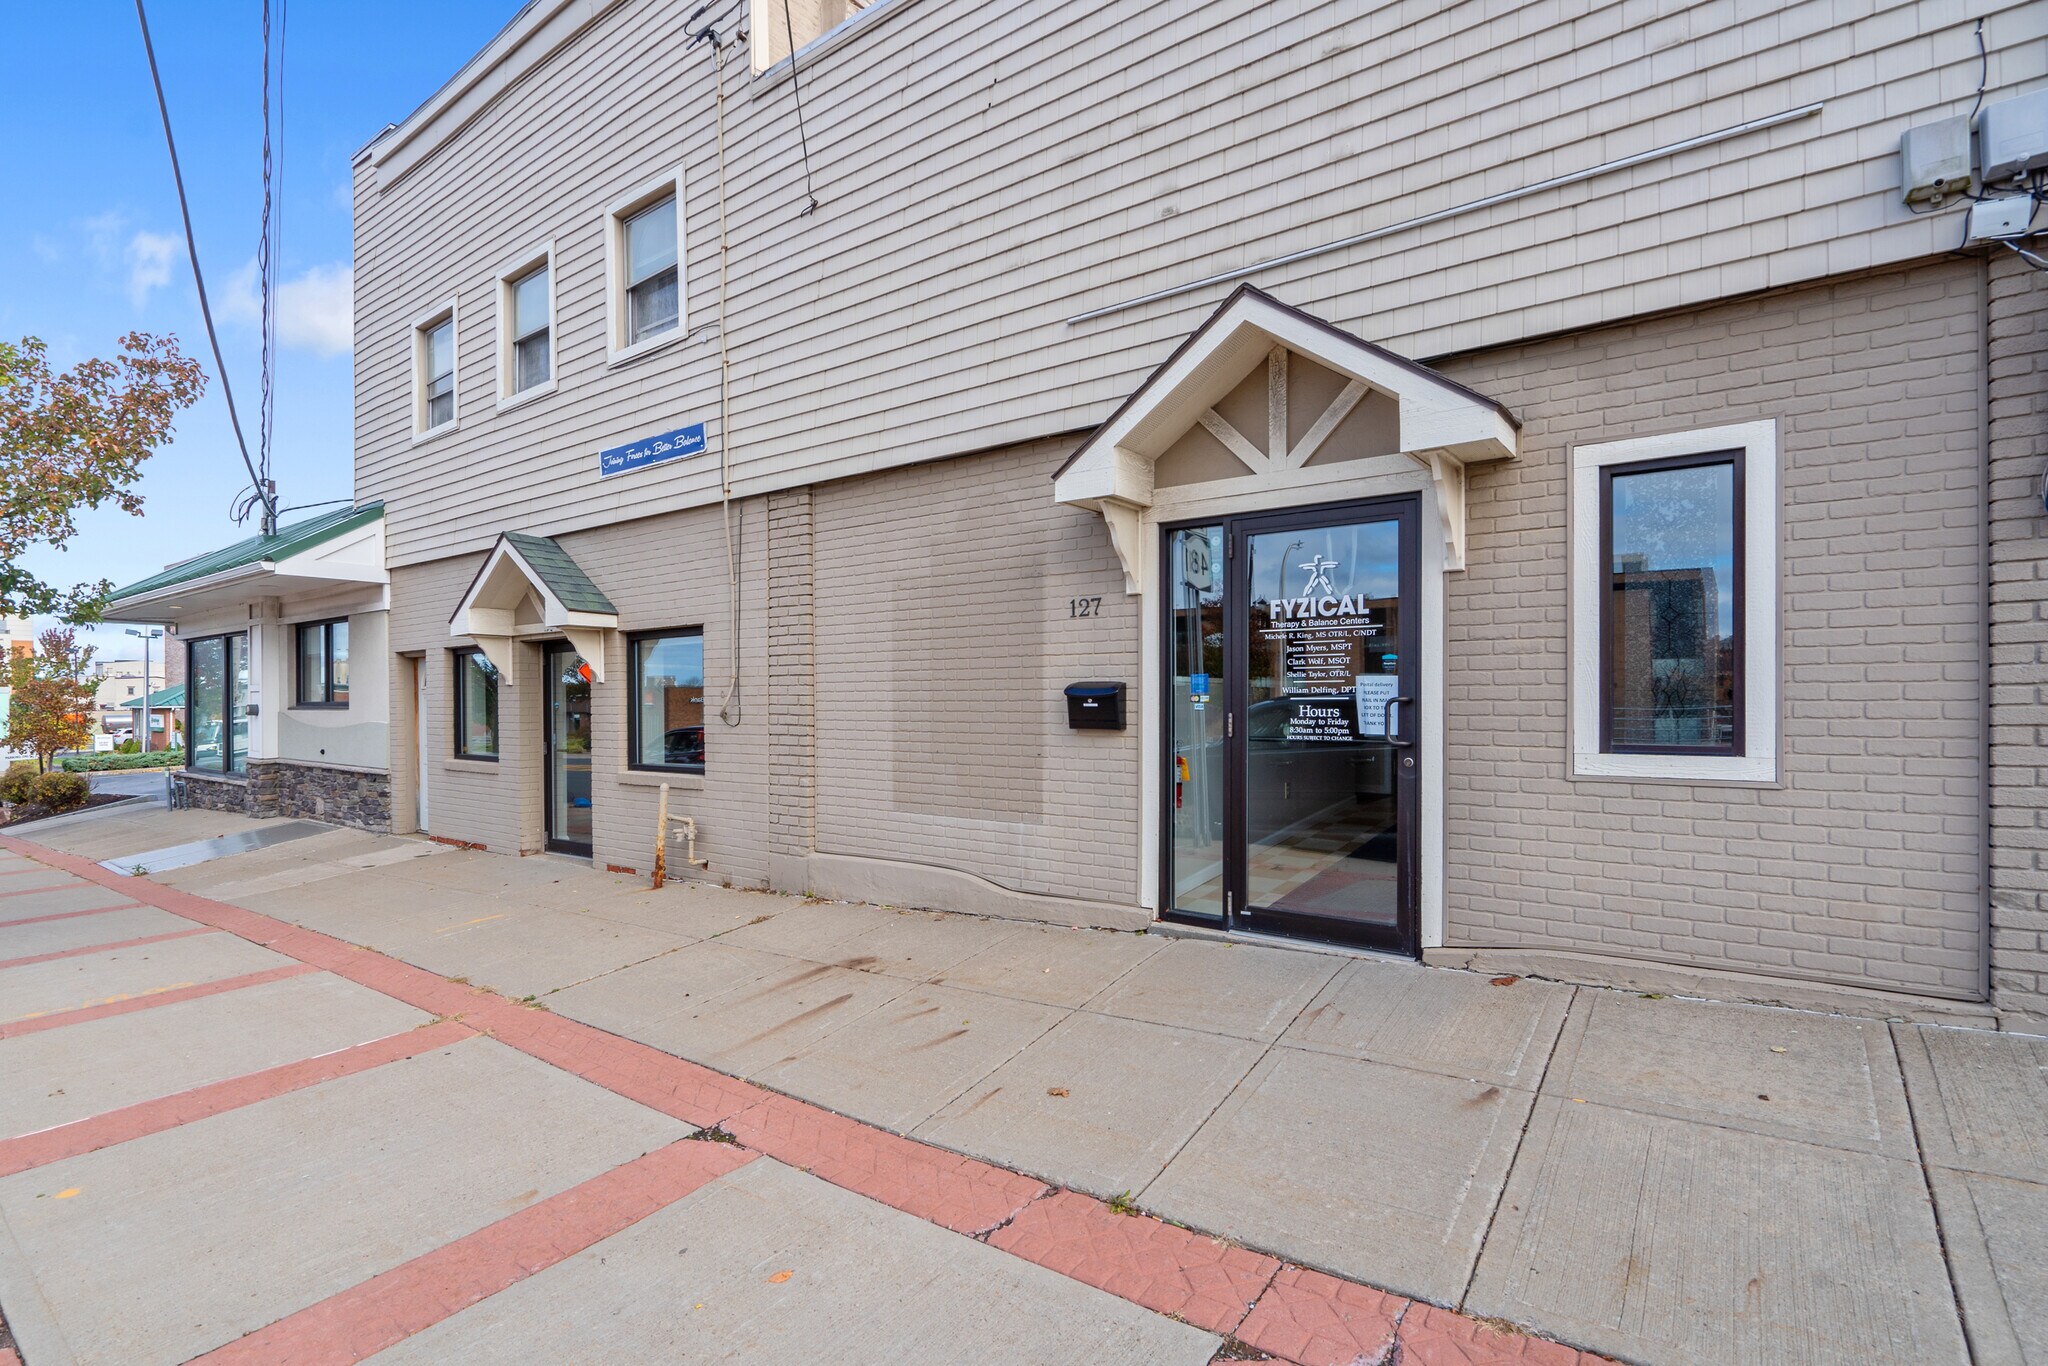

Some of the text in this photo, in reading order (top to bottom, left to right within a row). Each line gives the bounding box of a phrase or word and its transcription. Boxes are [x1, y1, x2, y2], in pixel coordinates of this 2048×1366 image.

[644, 448, 652, 458] for
[652, 442, 672, 455] Better
[674, 434, 702, 449] Balance
[1070, 597, 1102, 618] 127
[1270, 594, 1370, 620] FYZICAL
[1296, 632, 1314, 640] King,
[1306, 644, 1328, 653] Myers,
[1308, 671, 1328, 679] Taylor,
[1299, 705, 1340, 717] Hours
[1290, 718, 1316, 726] Monday
[1327, 718, 1349, 727] Friday
[1324, 727, 1349, 735] 5:00pm
